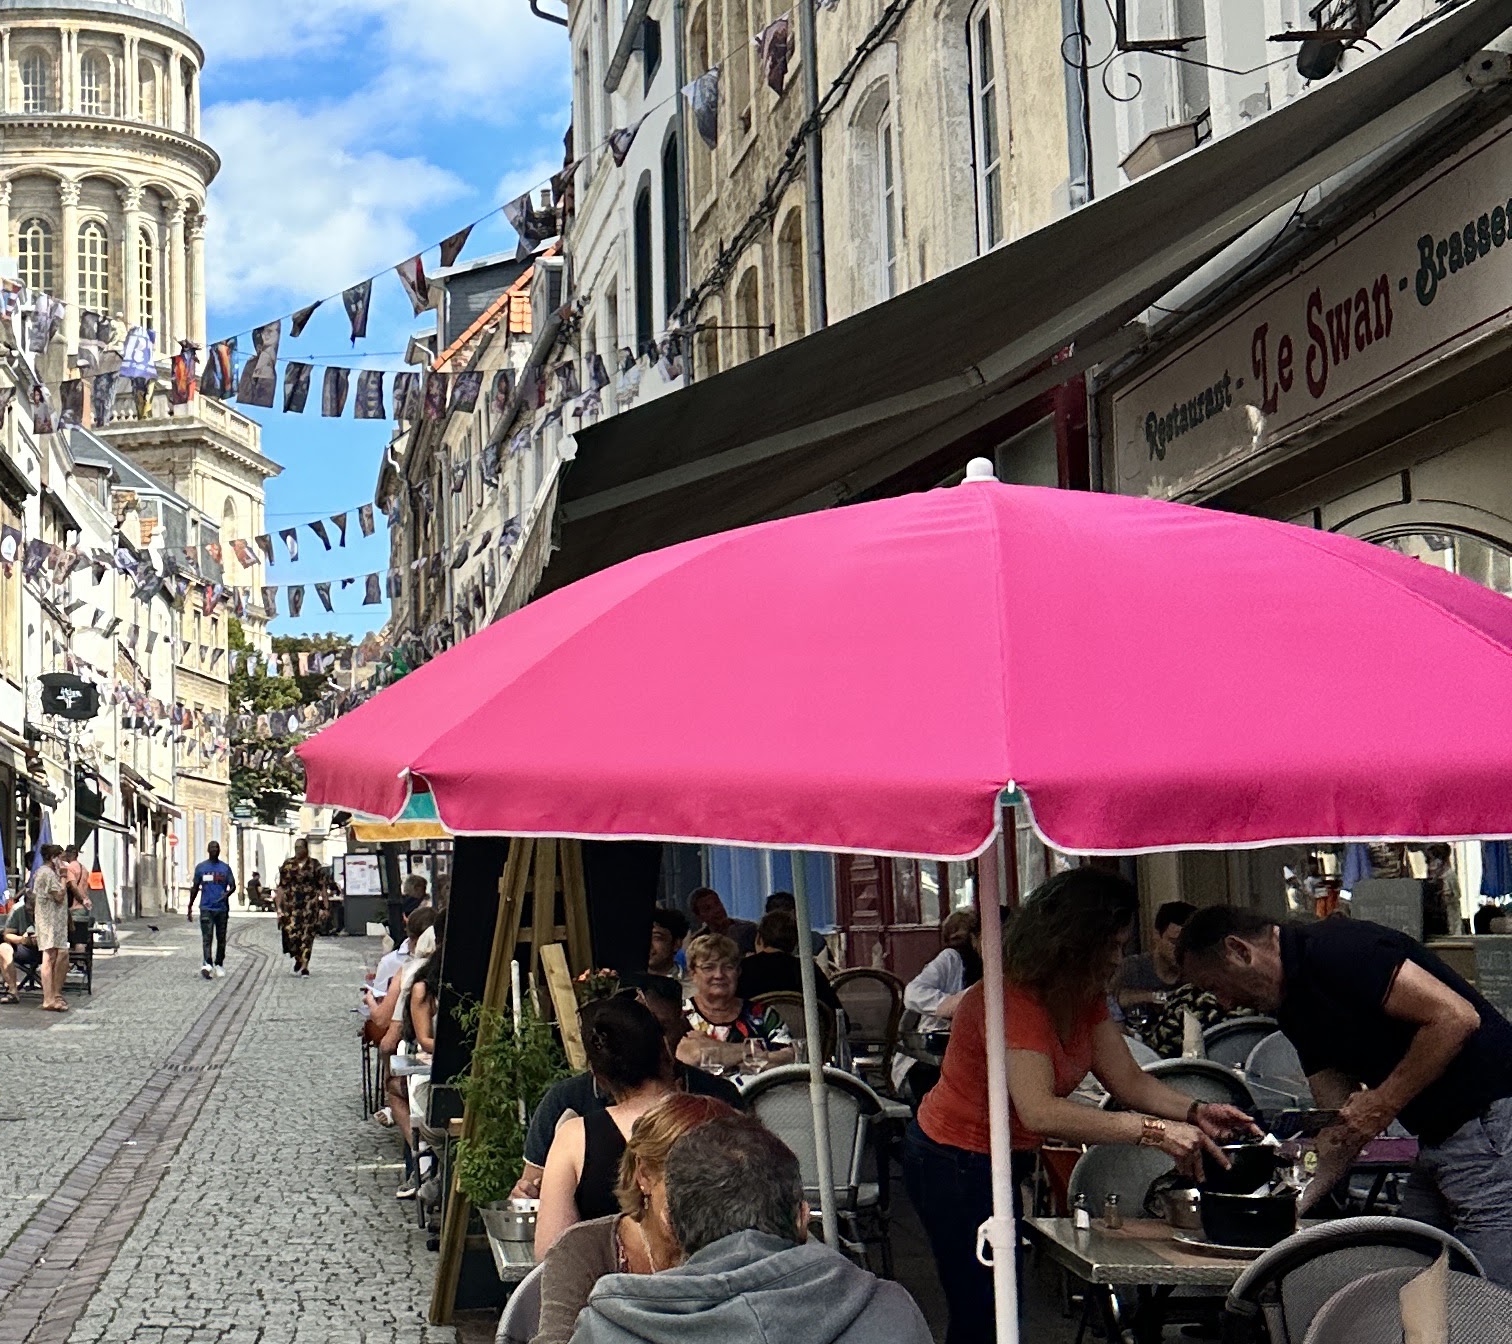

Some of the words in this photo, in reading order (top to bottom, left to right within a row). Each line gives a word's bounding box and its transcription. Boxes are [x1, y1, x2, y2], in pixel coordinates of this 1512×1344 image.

[1145, 369, 1233, 461] Restaurant
[1251, 321, 1294, 415] Le
[1305, 273, 1393, 399] Swan
